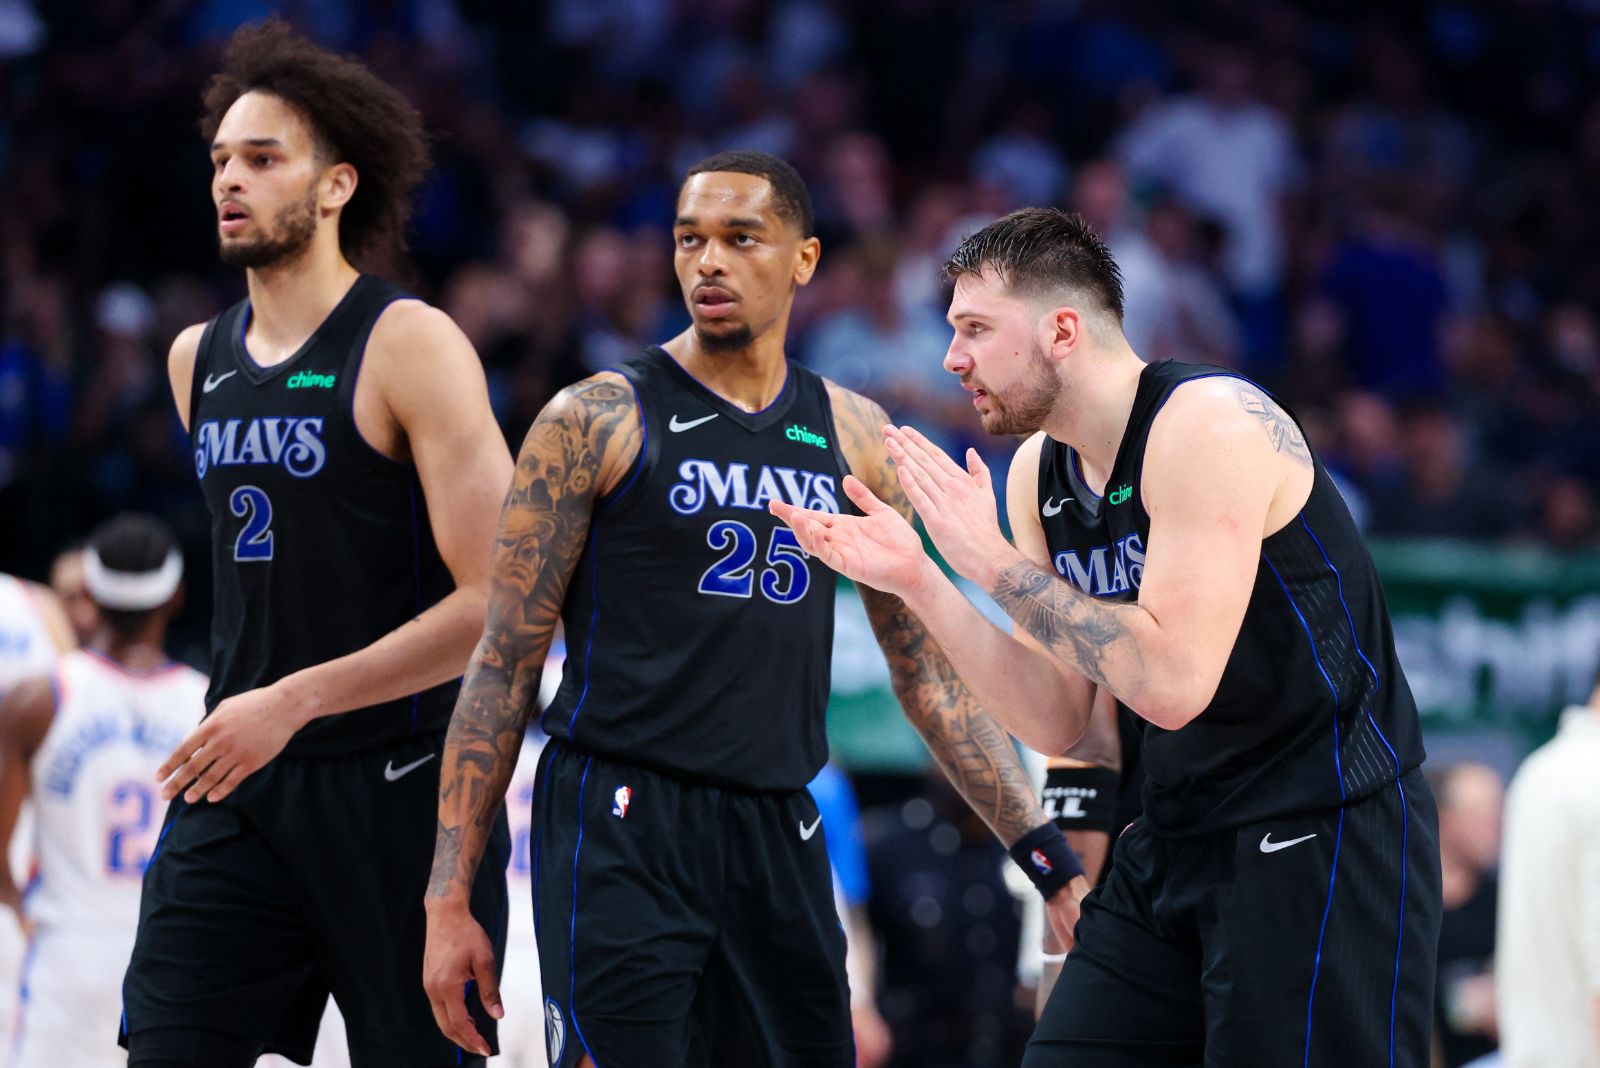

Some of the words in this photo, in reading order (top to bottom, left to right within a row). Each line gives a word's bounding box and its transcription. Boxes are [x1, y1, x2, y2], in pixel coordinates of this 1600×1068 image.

[287, 370, 336, 389] chime
[195, 416, 327, 480] MAVS
[785, 424, 828, 449] chime
[669, 458, 842, 515] MAVS
[1109, 484, 1133, 505] chim
[229, 485, 274, 562] 2
[698, 519, 811, 605] 25
